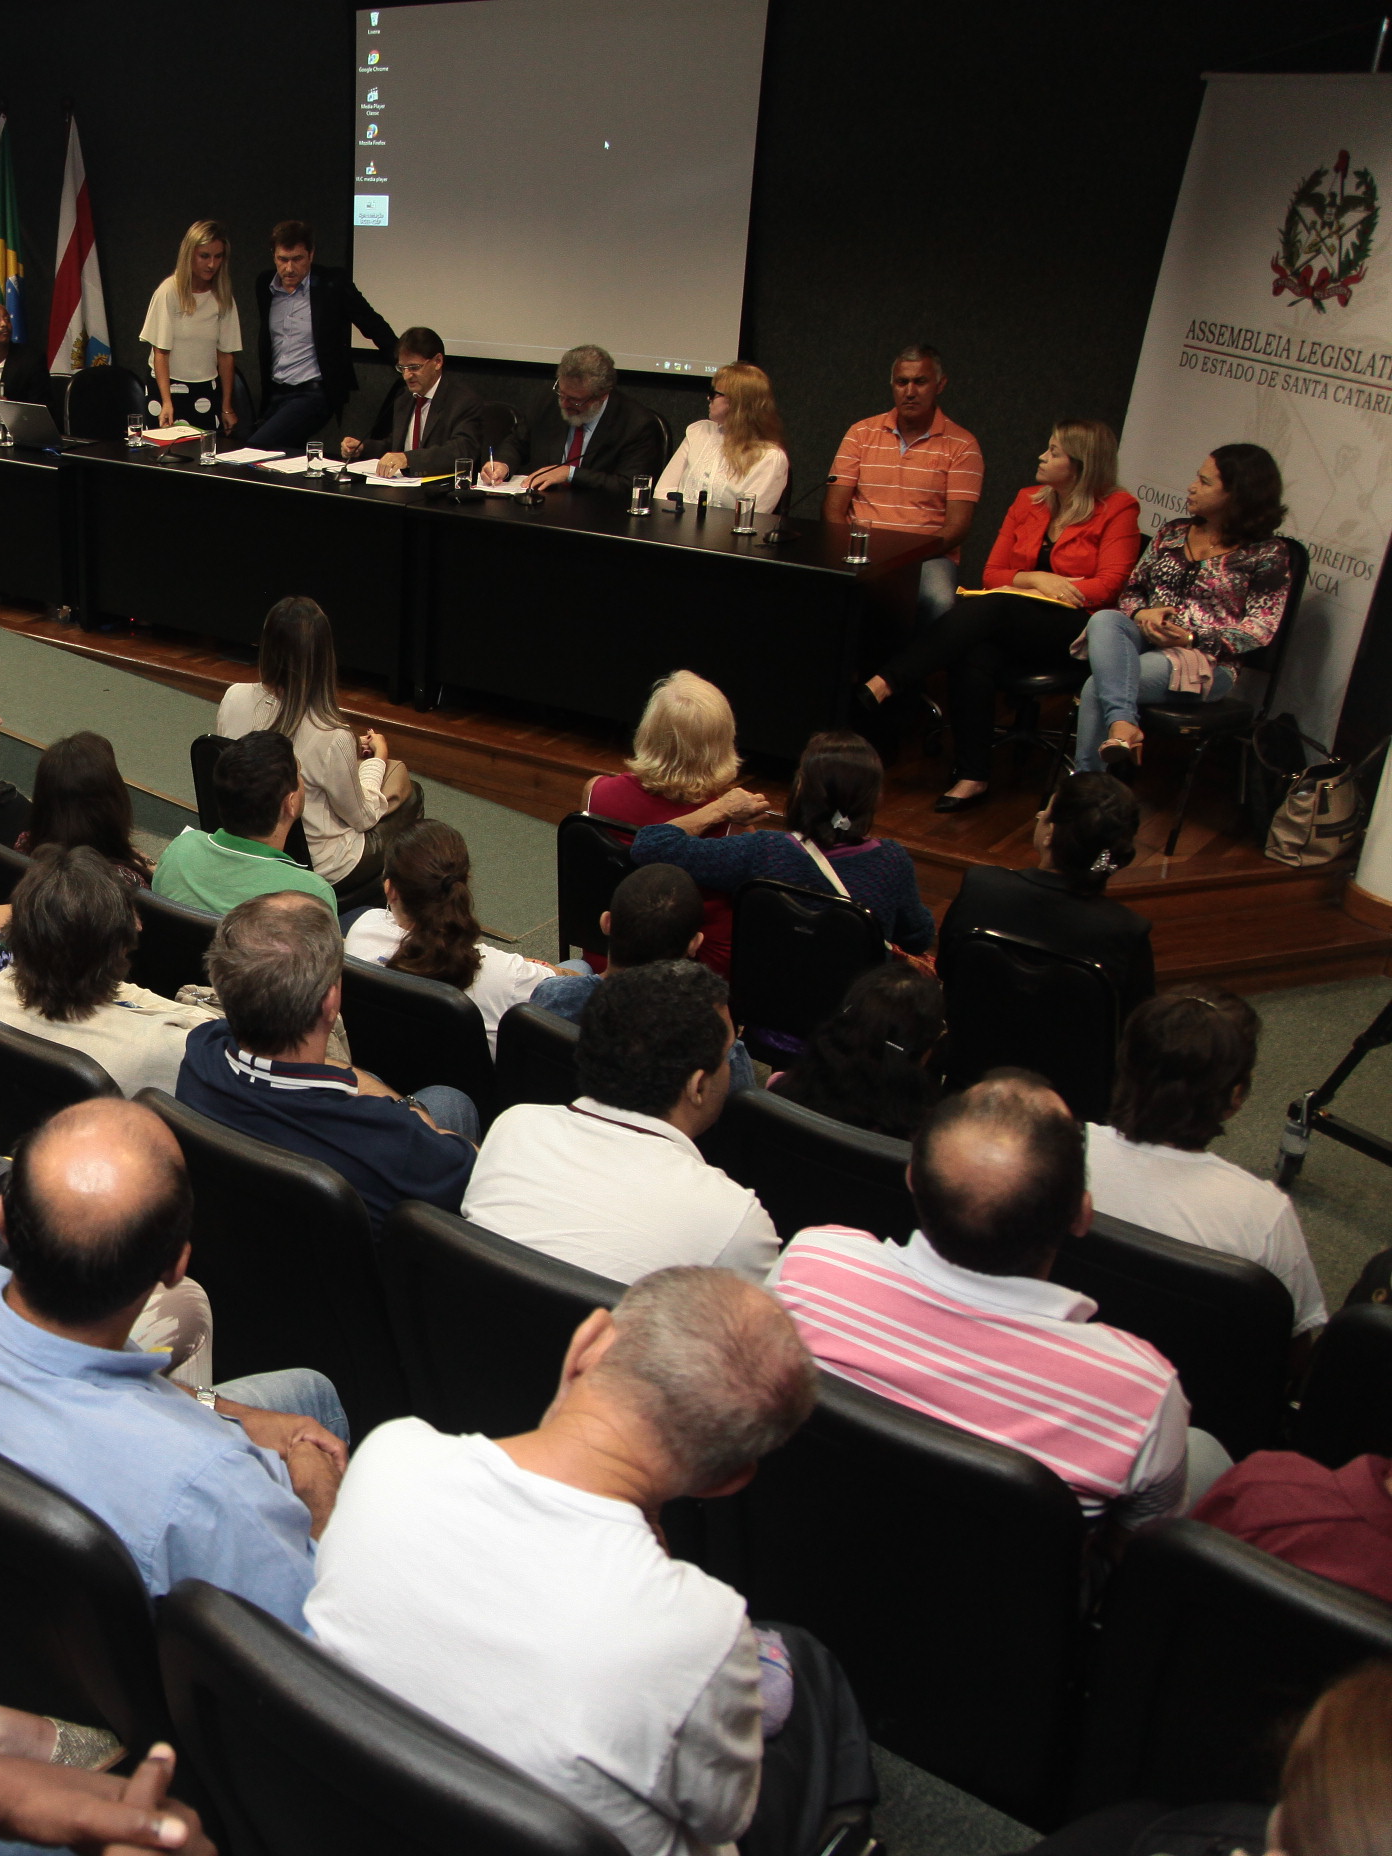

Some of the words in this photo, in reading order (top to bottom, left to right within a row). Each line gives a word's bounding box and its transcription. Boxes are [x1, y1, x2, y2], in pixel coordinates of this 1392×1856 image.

[1185, 319, 1291, 360] ASSEMBLEIA
[1179, 351, 1198, 370] DO
[1200, 356, 1255, 382] ESTADO
[1257, 368, 1279, 388] DE
[1281, 374, 1328, 400] SANTA
[1333, 385, 1392, 415] CATARI
[1308, 543, 1375, 581] DIREITOS
